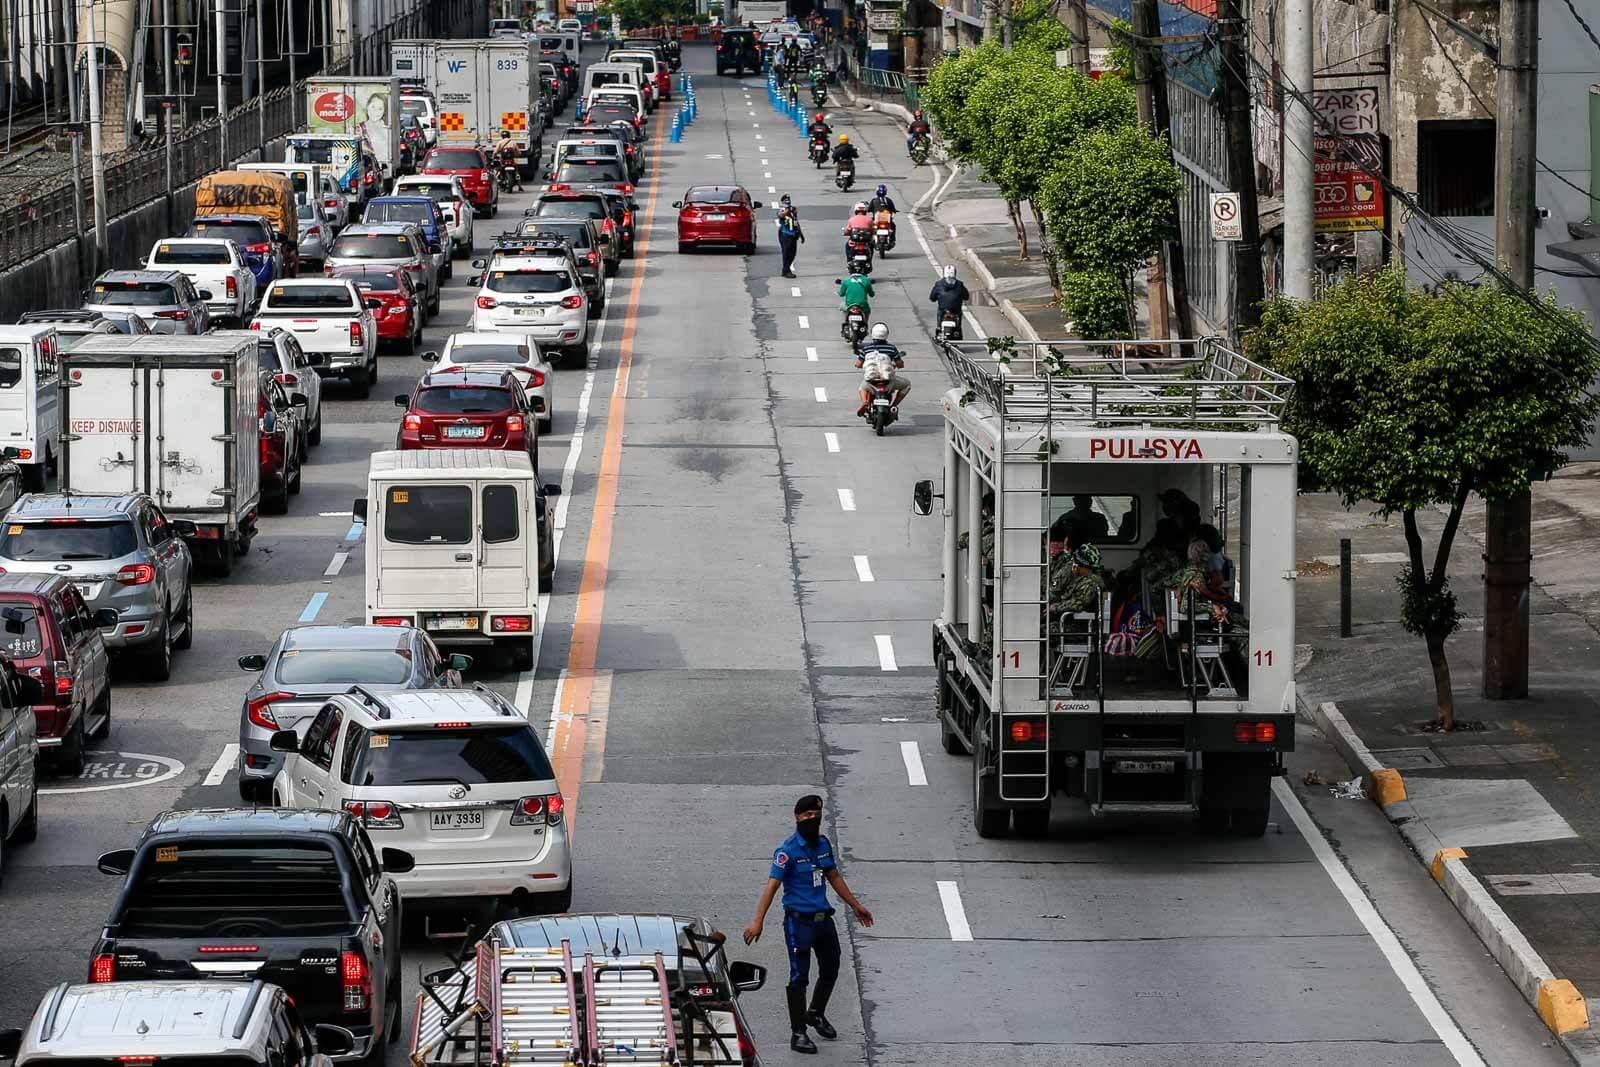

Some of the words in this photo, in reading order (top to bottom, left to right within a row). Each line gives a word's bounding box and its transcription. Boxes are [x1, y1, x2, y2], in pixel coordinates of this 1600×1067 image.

[448, 60, 467, 73] WF
[497, 59, 519, 71] 839
[72, 421, 95, 433] KEEP
[99, 421, 142, 433] DISTANCE
[1090, 438, 1203, 460] PULISYA
[1254, 650, 1273, 666] 11
[434, 814, 453, 825] AAY
[456, 813, 481, 825] 3938
